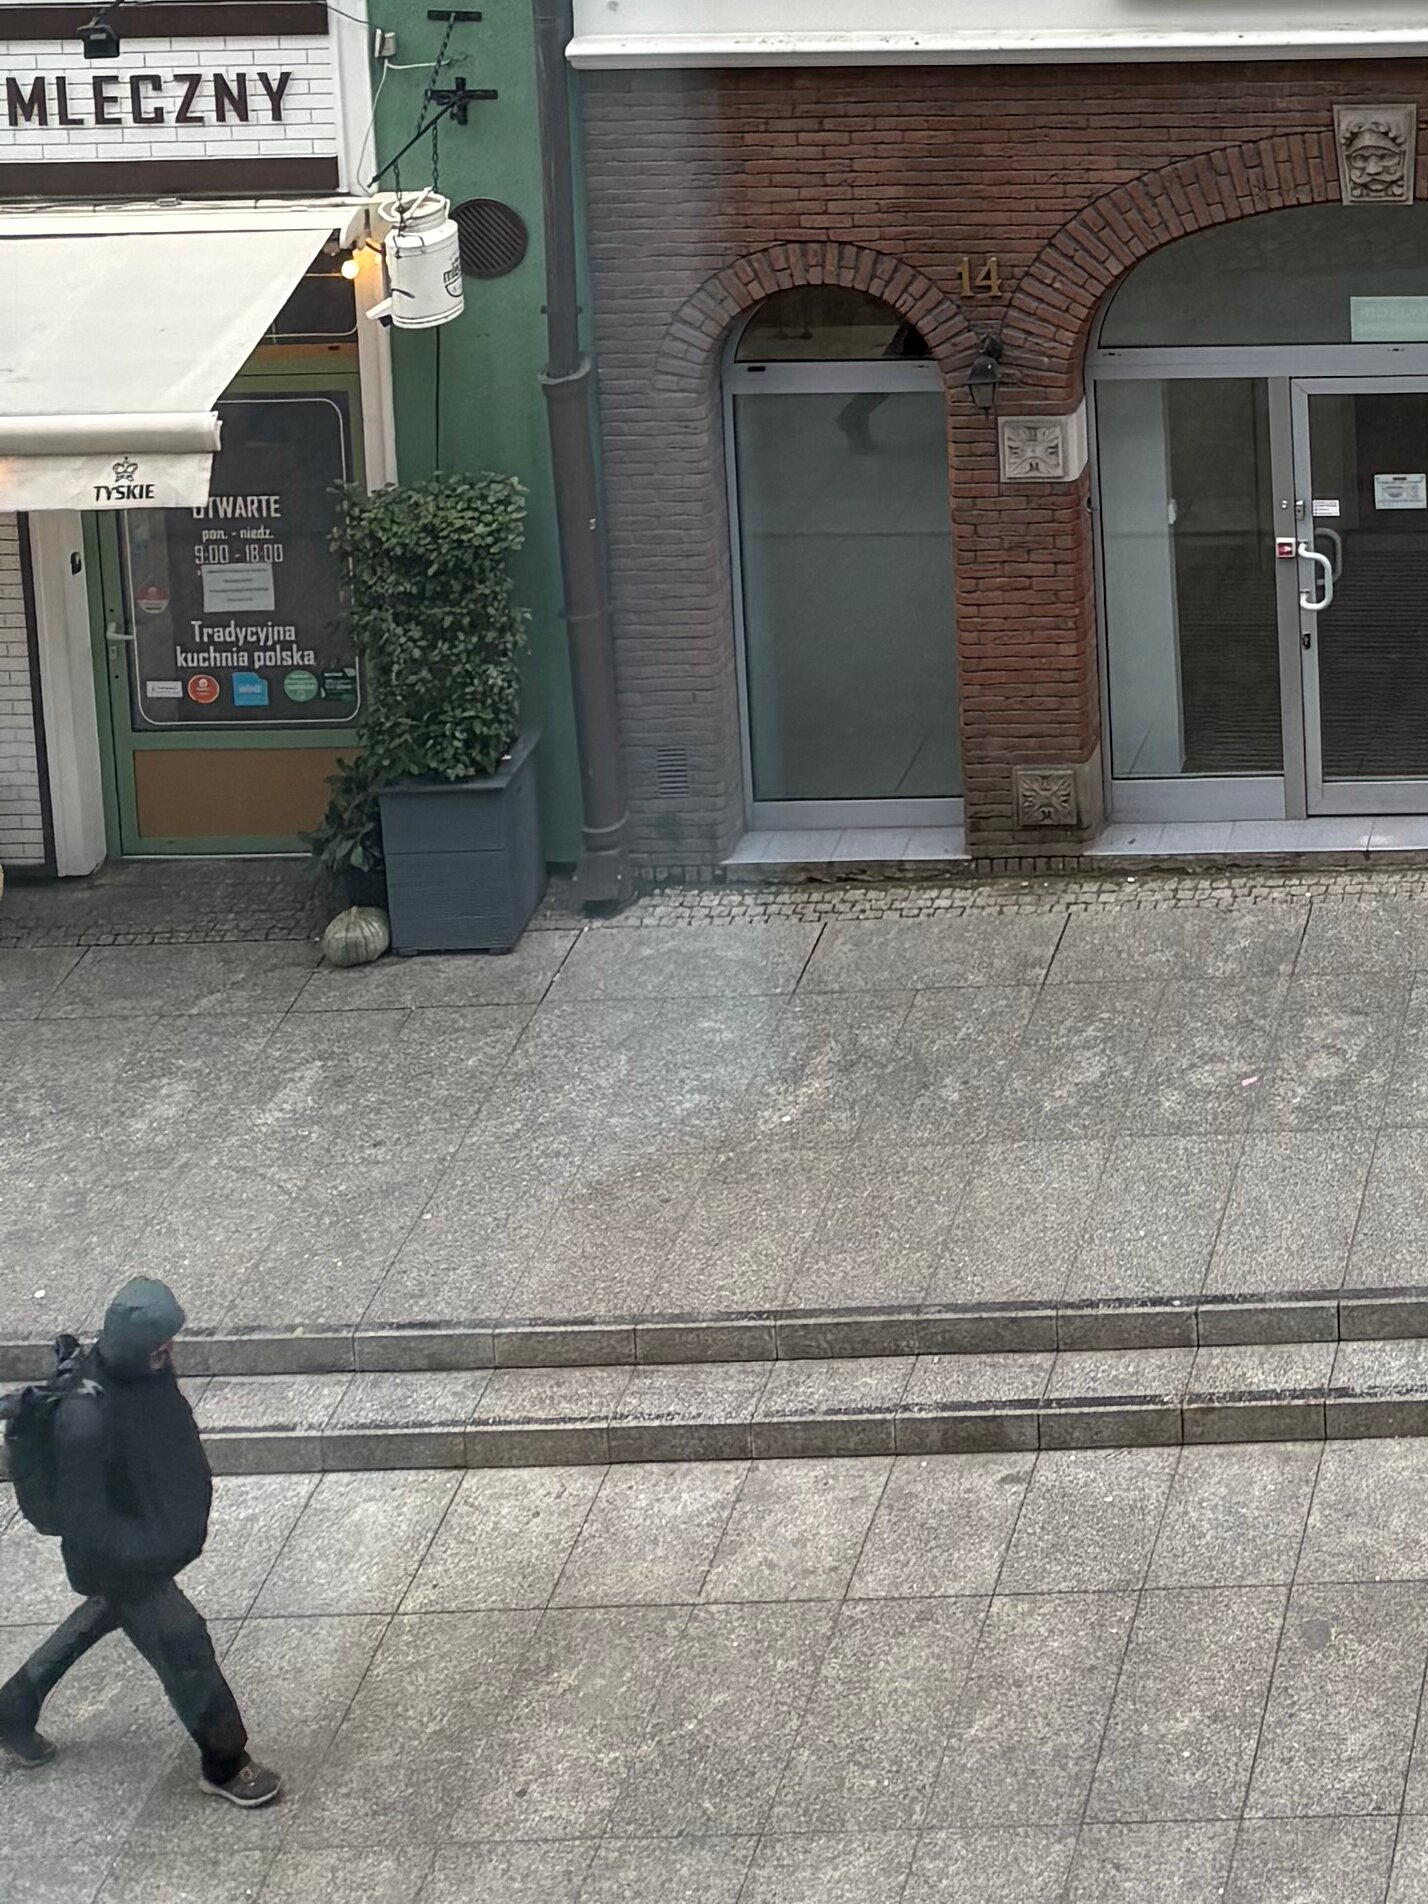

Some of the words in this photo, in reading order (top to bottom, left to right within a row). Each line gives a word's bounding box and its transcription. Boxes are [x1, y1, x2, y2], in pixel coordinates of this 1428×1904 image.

[6, 72, 291, 126] MLECZNY
[960, 256, 1003, 297] 14
[94, 484, 156, 502] TYSKIE
[195, 545, 229, 564] 9:00
[245, 543, 284, 563] 18:00
[191, 620, 296, 646] Tradycyjna
[176, 645, 249, 667] kuchnia
[254, 644, 315, 669] polska
